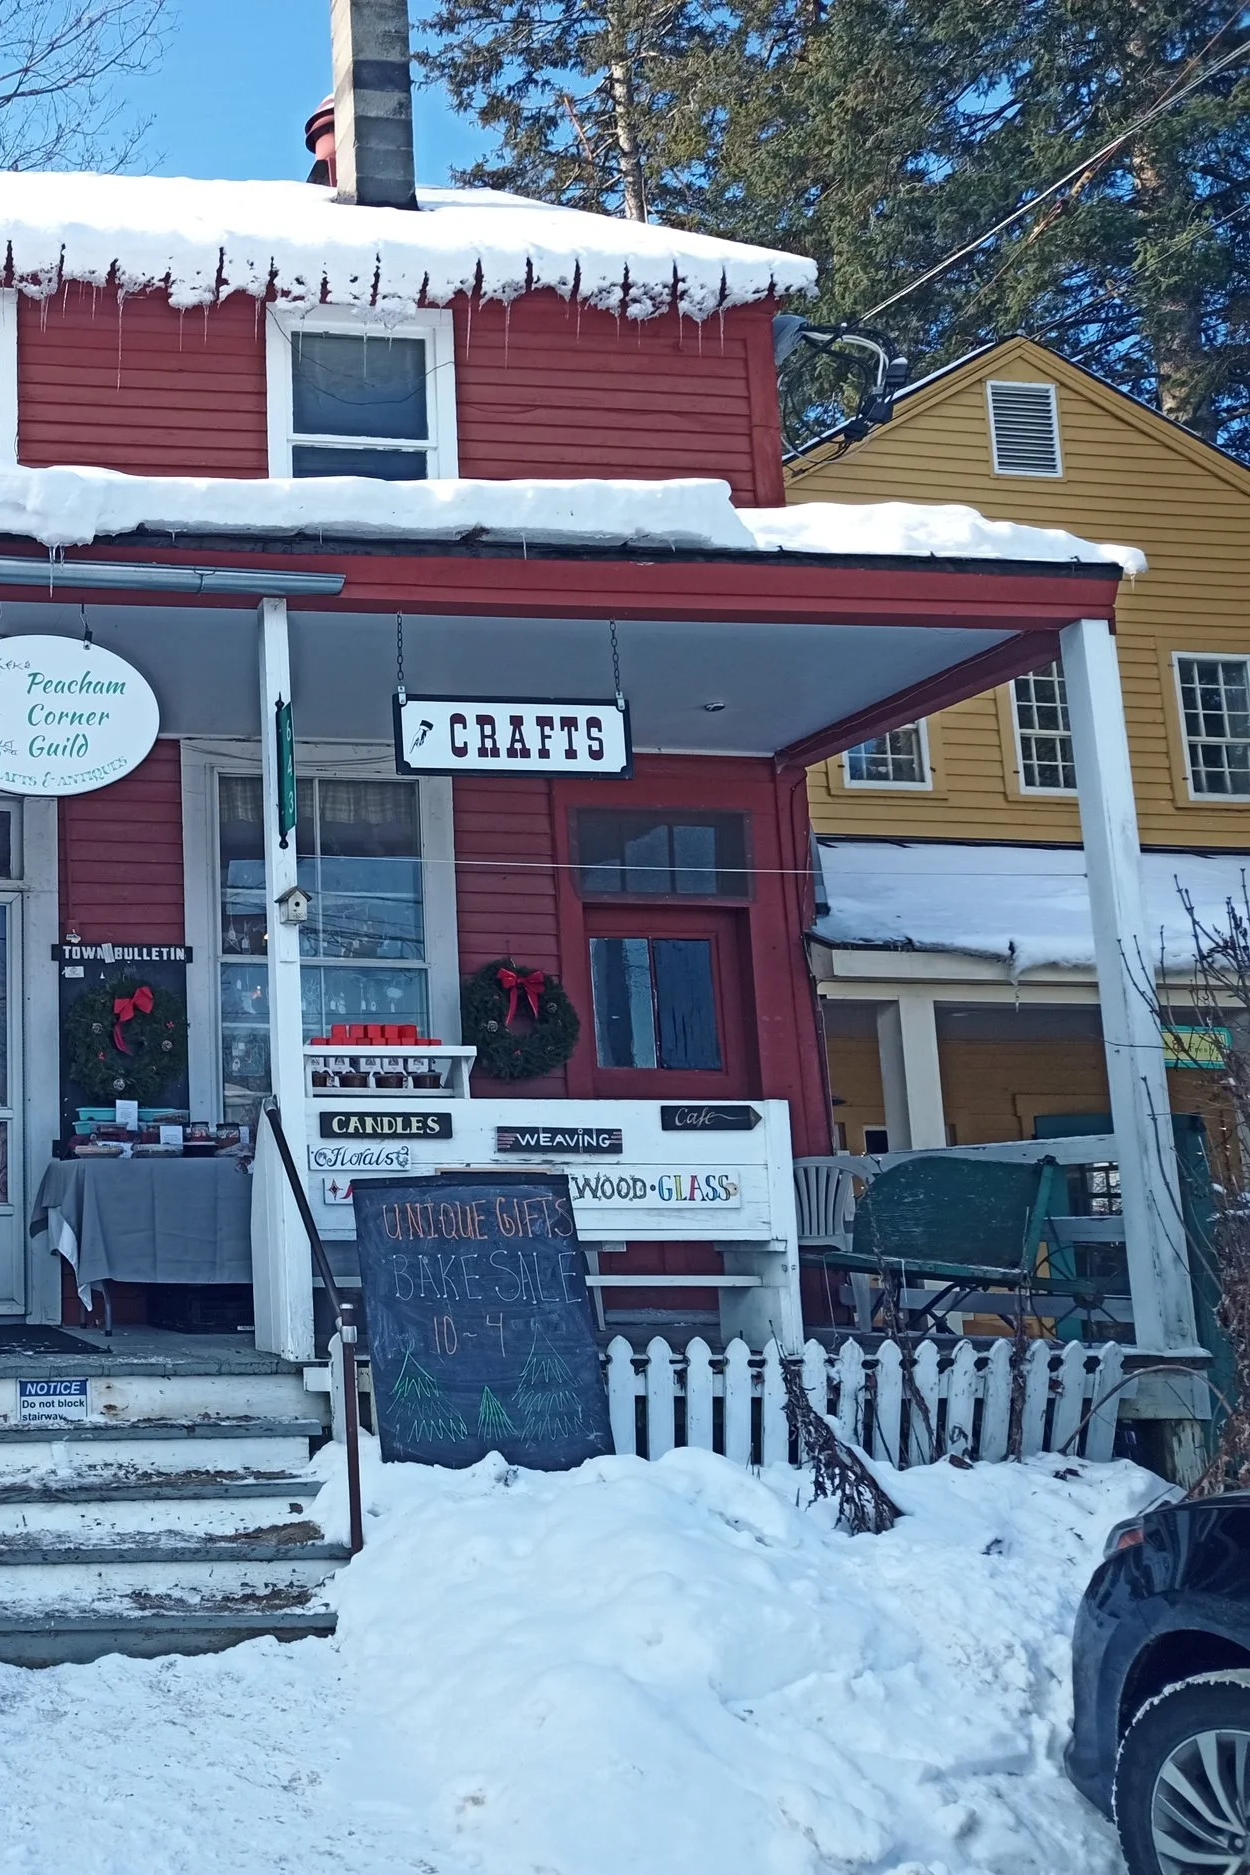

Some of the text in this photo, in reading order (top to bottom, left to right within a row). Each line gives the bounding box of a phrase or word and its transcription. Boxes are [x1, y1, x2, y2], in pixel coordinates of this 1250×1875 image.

[26, 670, 126, 695] Peacham
[27, 703, 110, 727] Corner
[28, 733, 90, 759] Guild
[449, 712, 604, 761] CRAFTS
[57, 756, 128, 787] ANTIQUES
[114, 947, 185, 960] BULLETIN
[332, 1116, 440, 1134] CANDLES
[675, 1107, 716, 1127] Cafe
[315, 1146, 395, 1167] Florals
[572, 1174, 731, 1201] WOOD GLASS
[382, 1196, 574, 1240] UNIQUE GIFTS
[392, 1250, 582, 1304] BAKE SALE
[486, 1313, 507, 1357] 4
[26, 1382, 81, 1395] NOTICE
[22, 1399, 85, 1408] Do not block
